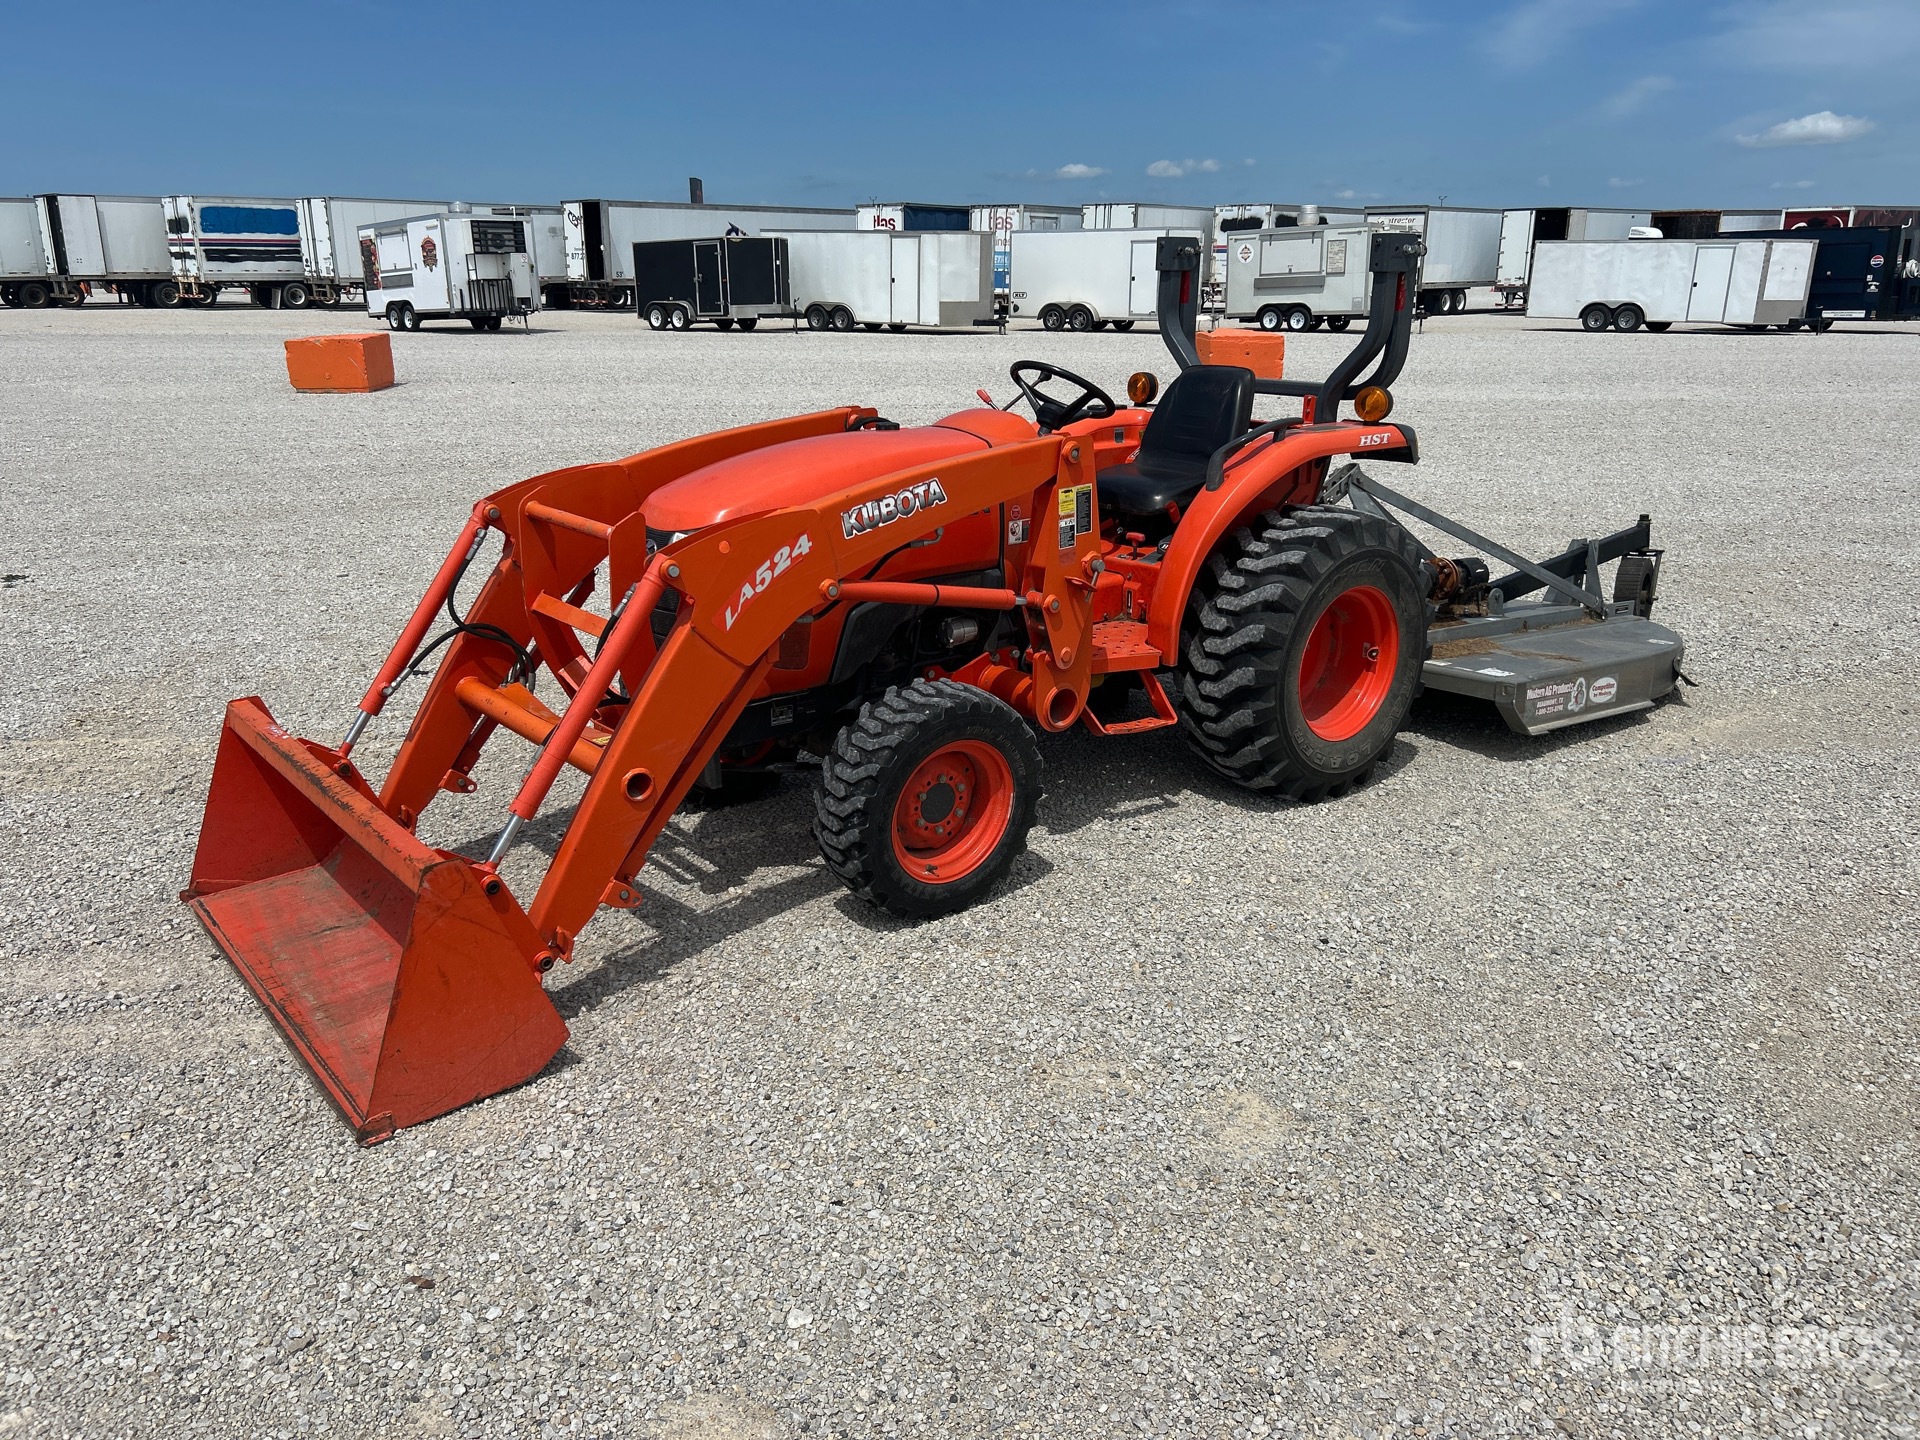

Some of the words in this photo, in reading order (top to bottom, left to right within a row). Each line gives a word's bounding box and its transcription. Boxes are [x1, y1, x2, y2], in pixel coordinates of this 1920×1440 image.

[1359, 432, 1392, 447] HST
[841, 477, 947, 539] KUBOTA
[724, 532, 813, 632] LA524
[1552, 682, 1575, 695] Products
[1293, 727, 1372, 768] LOADER
